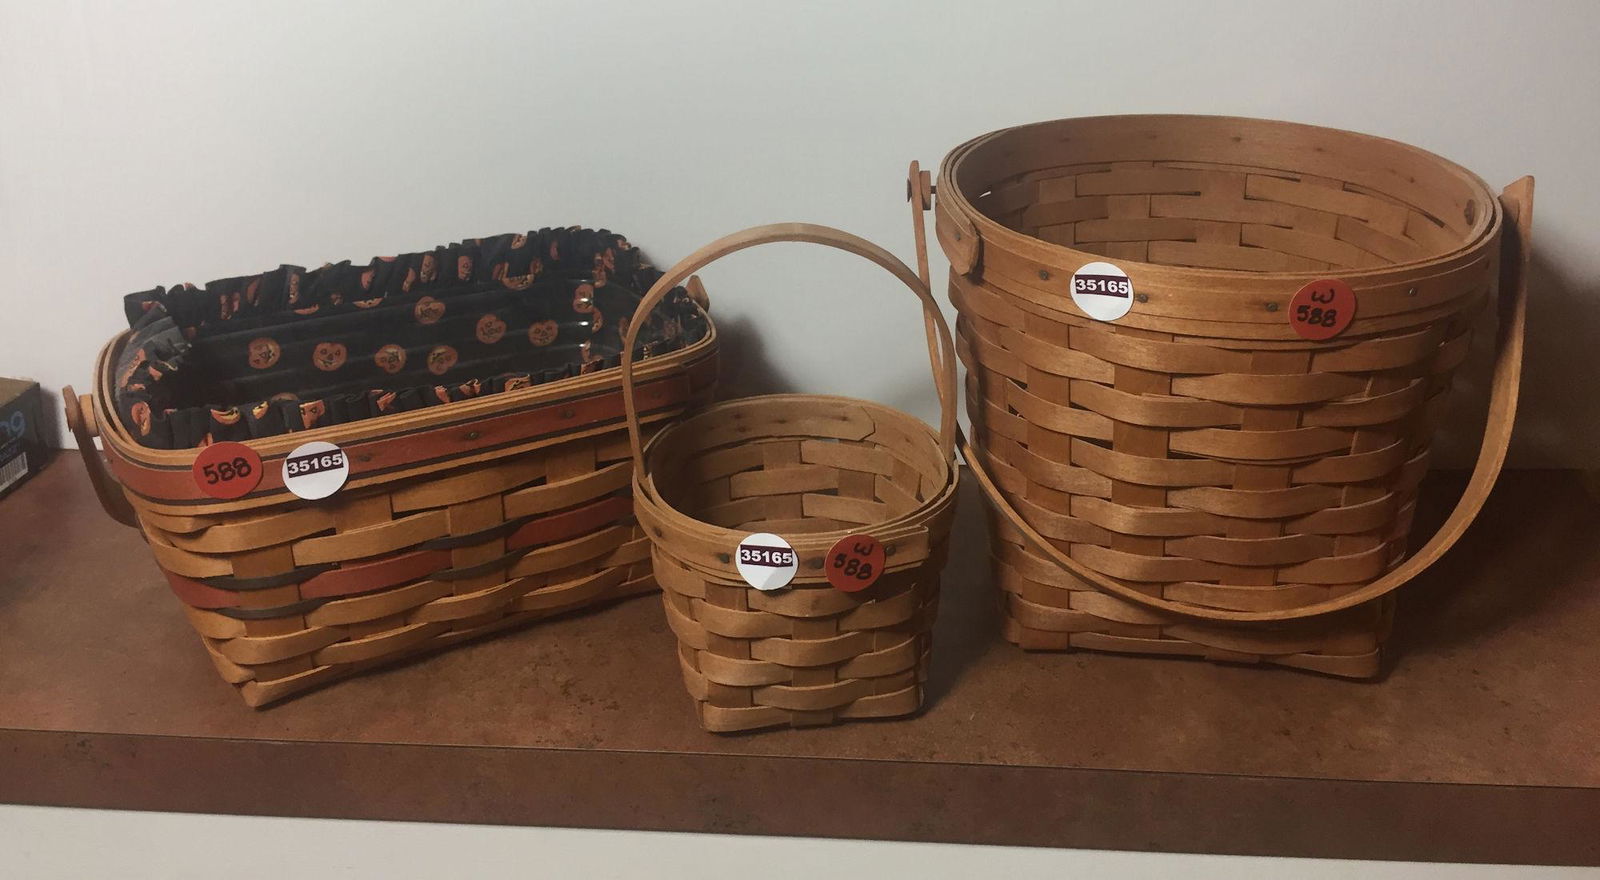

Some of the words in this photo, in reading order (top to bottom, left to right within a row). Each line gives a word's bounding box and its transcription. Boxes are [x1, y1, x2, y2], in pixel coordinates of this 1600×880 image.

[1075, 279, 1128, 294] 35165
[1297, 305, 1337, 327] 588
[203, 456, 252, 485] 588
[287, 453, 343, 474] 35165
[741, 549, 792, 564] 35165
[833, 553, 872, 580] 588
